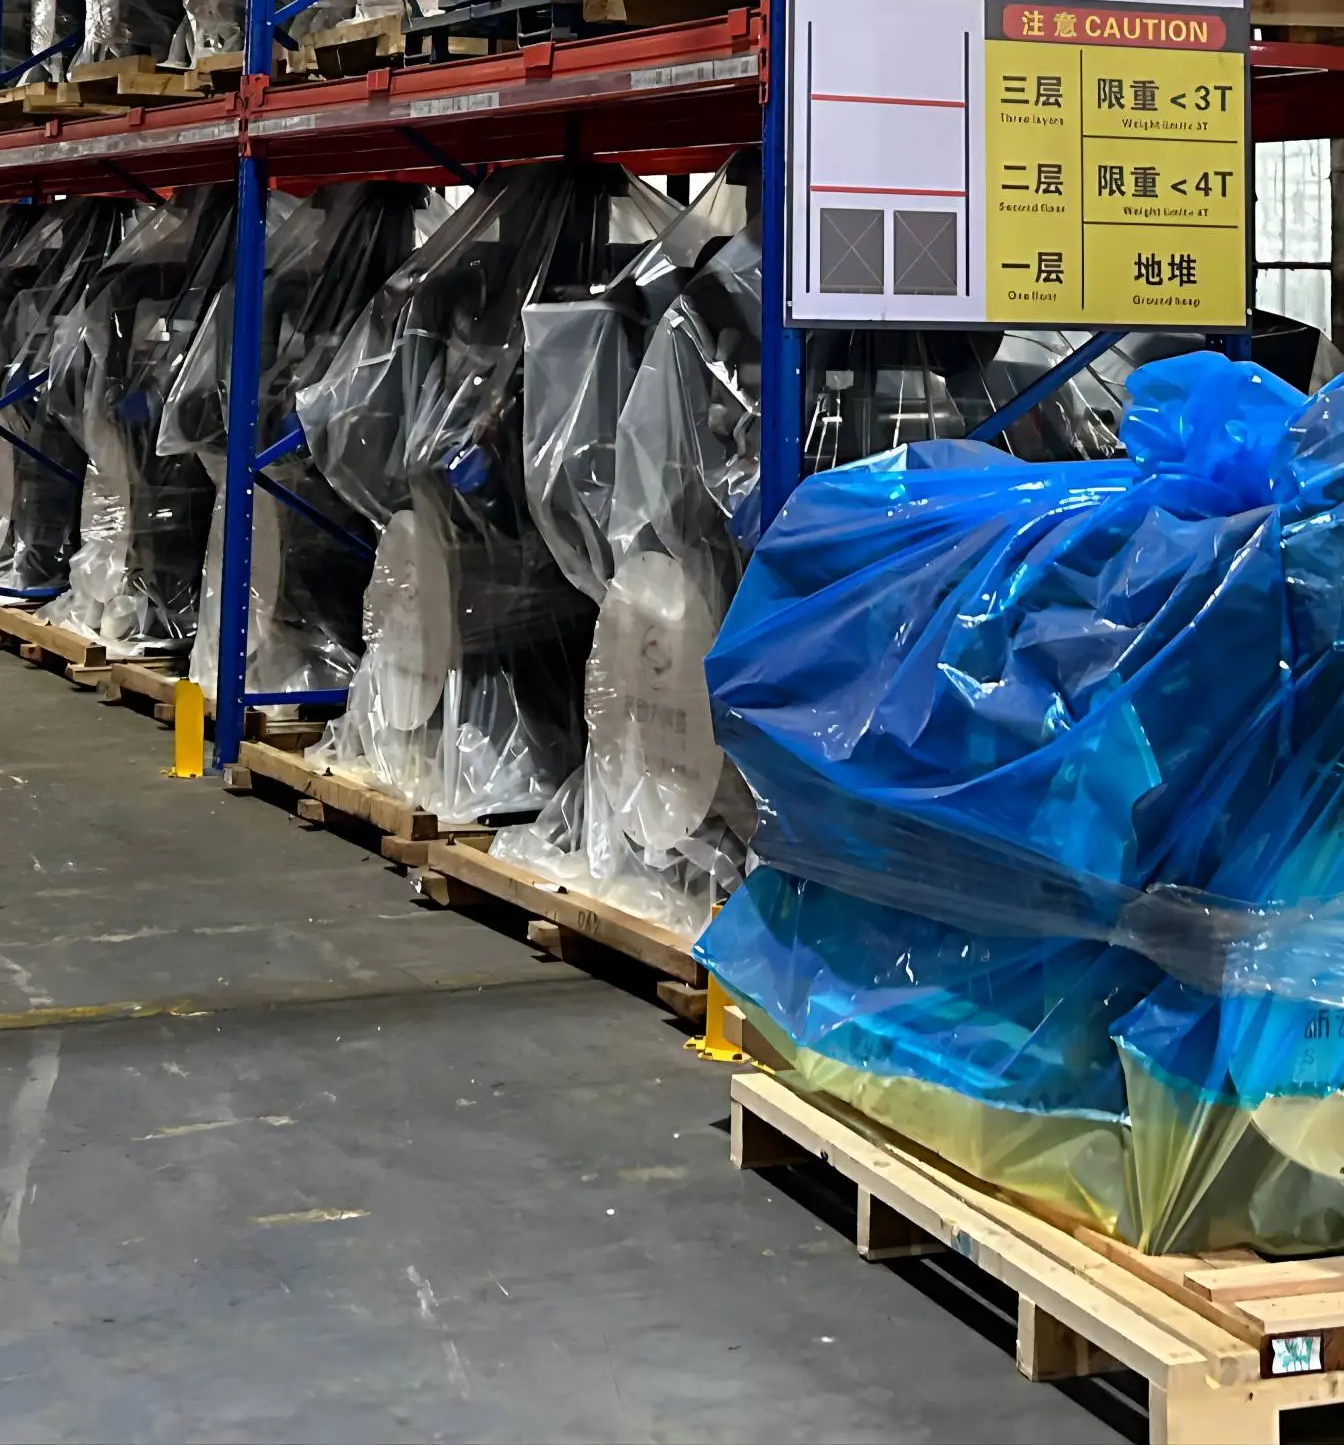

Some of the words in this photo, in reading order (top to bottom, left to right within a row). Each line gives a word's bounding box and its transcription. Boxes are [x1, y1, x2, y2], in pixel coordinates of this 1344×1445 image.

[1022, 10, 1077, 37] 注意
[1085, 15, 1208, 43] CAUTION
[1000, 75, 1063, 108] 三层
[1001, 163, 1064, 196] 二层
[1001, 252, 1064, 285] 一层
[1133, 252, 1197, 287] 地堆
